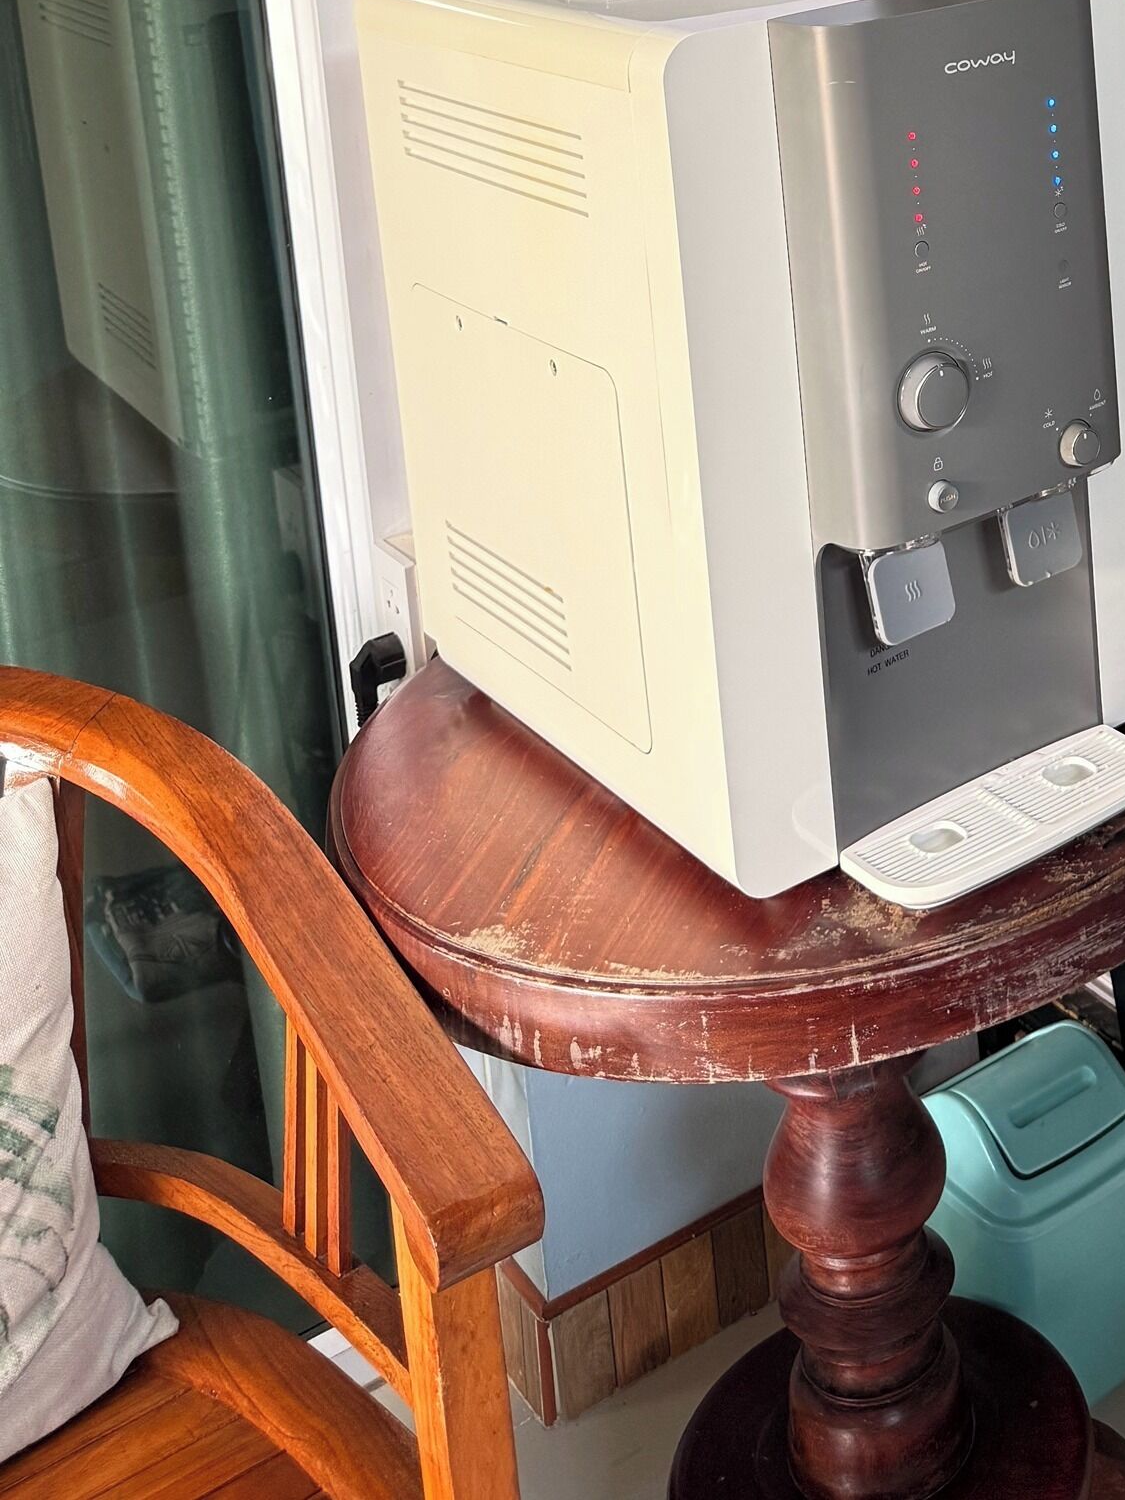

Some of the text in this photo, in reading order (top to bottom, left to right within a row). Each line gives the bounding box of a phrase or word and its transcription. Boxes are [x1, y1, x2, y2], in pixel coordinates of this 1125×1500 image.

[944, 50, 1016, 75] coway
[920, 326, 937, 335] WARM
[983, 371, 993, 379] HOT
[1042, 420, 1056, 429] COLD
[867, 649, 910, 677] HOT WATER
